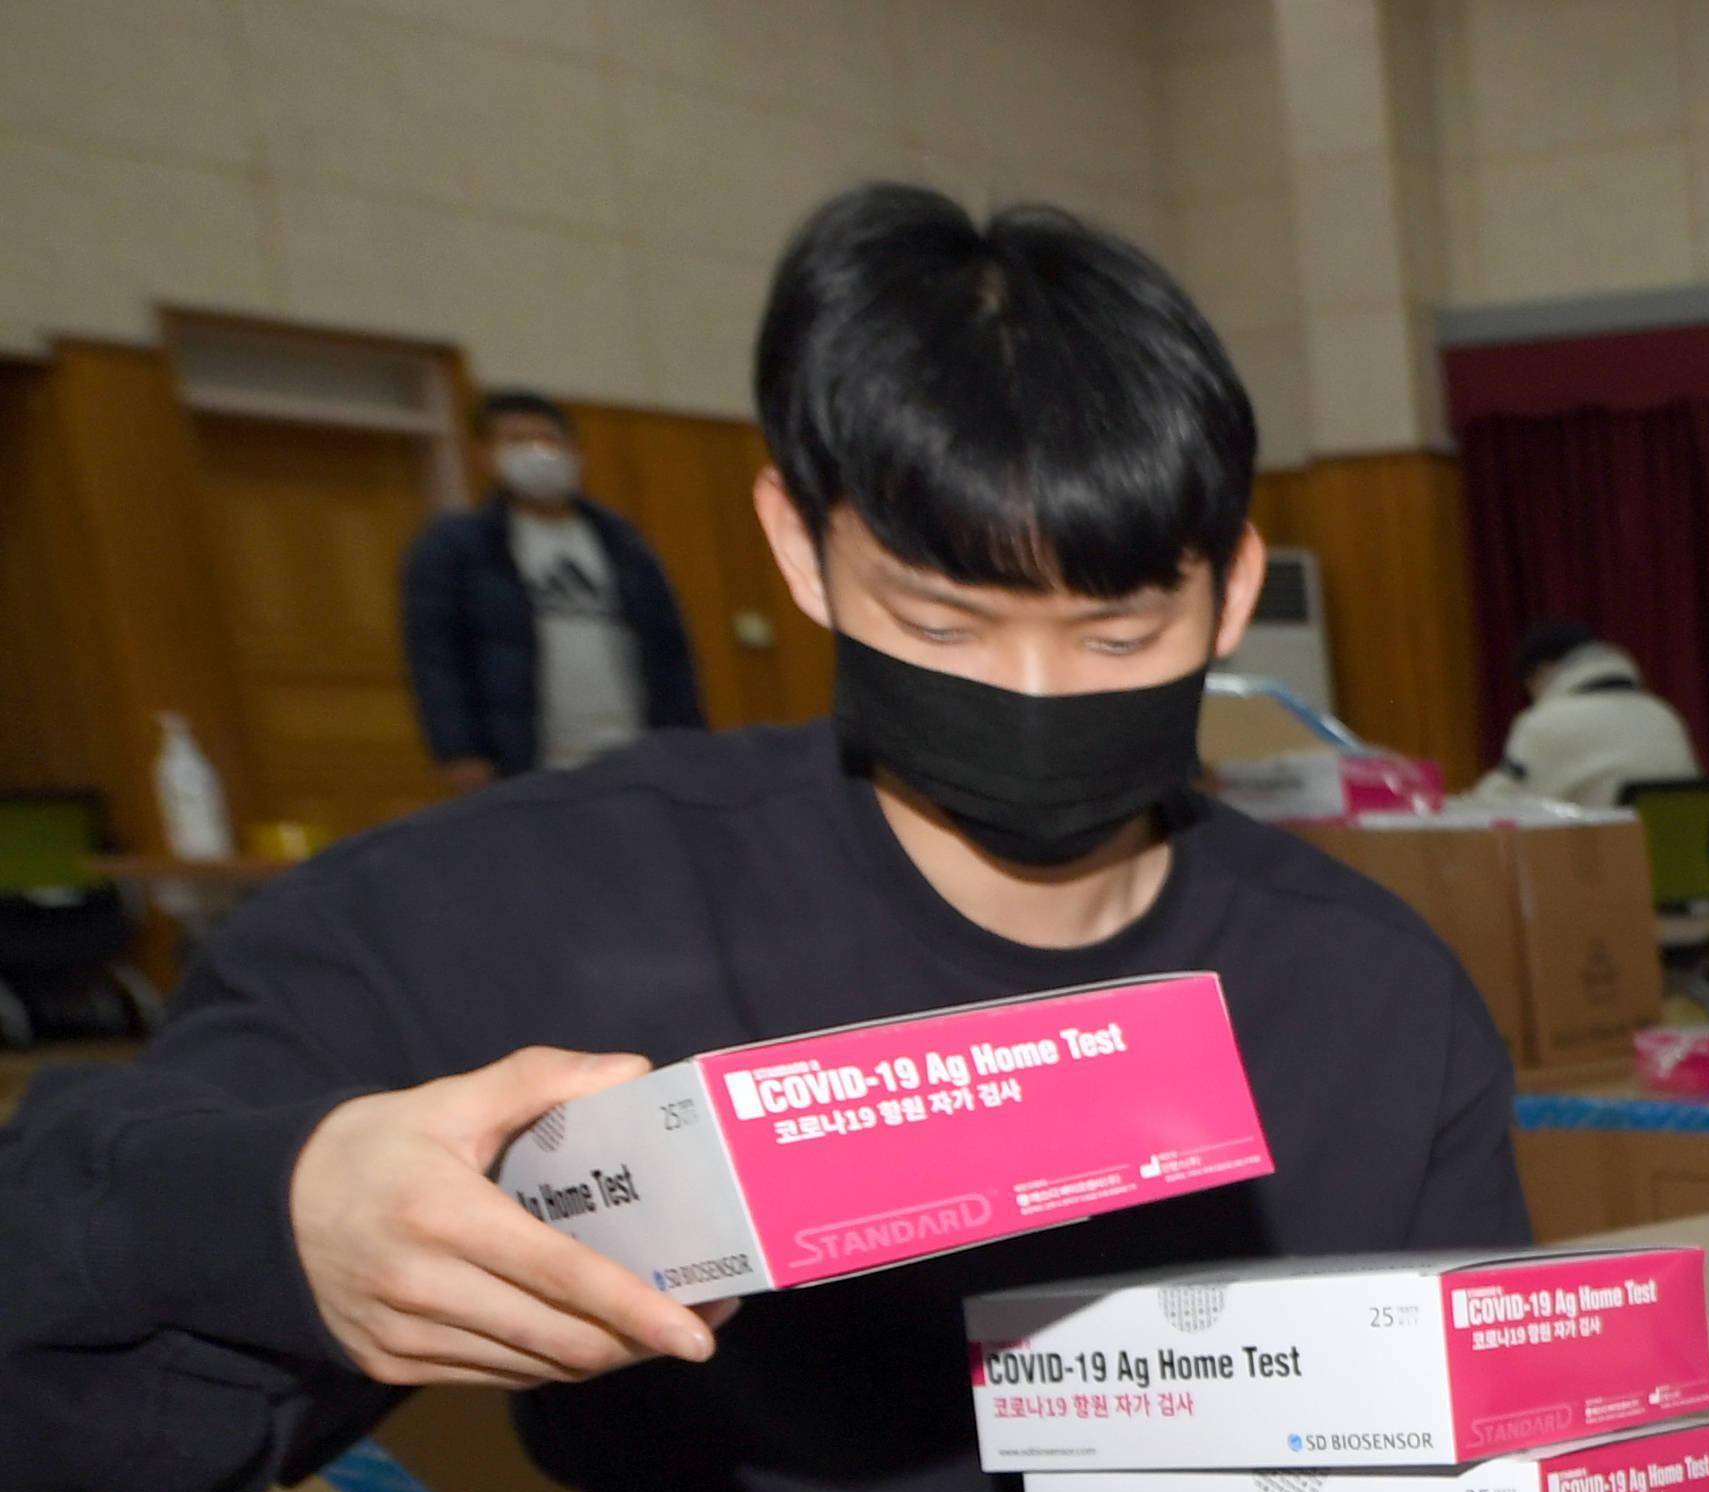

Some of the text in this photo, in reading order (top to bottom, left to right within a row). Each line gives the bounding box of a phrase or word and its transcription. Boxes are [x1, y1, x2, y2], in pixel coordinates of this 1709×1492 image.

[760, 1057, 919, 1114] COVID-19
[925, 1052, 971, 1087] Ag
[970, 1039, 1060, 1076] Home
[1060, 1022, 1128, 1061] Test
[877, 1077, 1023, 1126] 항원 자가 검사
[591, 1164, 640, 1208] Test
[789, 1191, 992, 1268] STANDARD
[1370, 1307, 1395, 1329] 25
[1555, 1279, 1658, 1319] Ag Home Test
[985, 1345, 1302, 1388] COVID-19 Ag Home Test
[994, 1391, 1195, 1419] 코로나19 자가 검사
[1306, 1432, 1434, 1451] SD BIOSENSOR
[1649, 1460, 1684, 1488] Home
